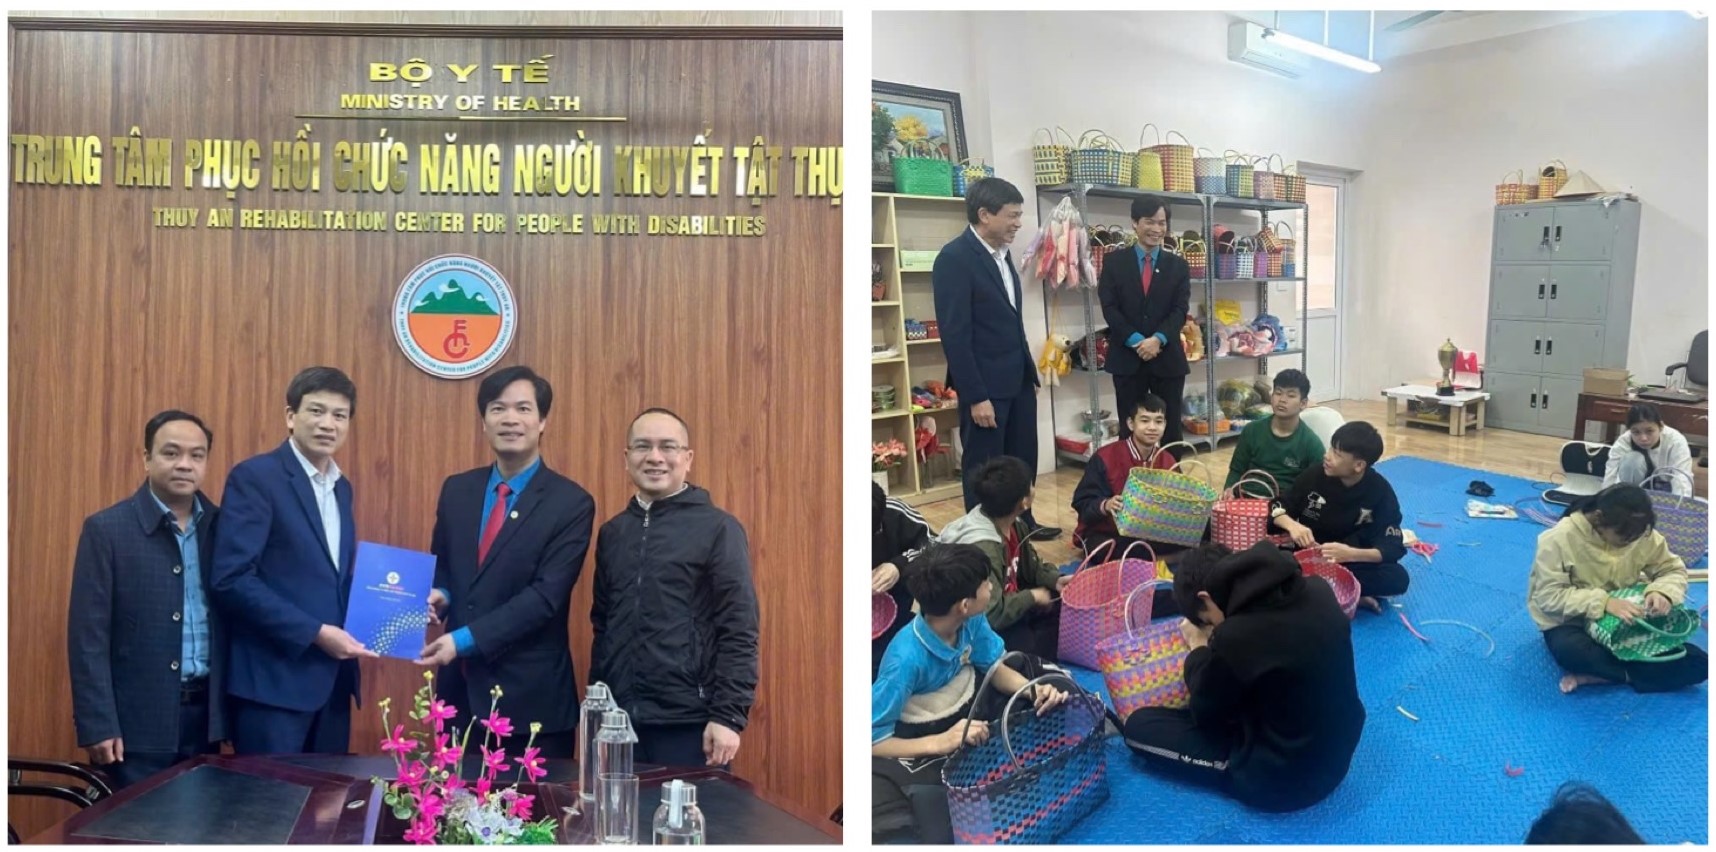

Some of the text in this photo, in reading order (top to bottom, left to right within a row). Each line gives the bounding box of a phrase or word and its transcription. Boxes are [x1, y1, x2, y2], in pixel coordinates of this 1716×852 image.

[369, 54, 555, 88] BỘ Y TẾ
[341, 94, 580, 112] MINISTRY OF HEALTH
[11, 134, 102, 187] TRUNG
[112, 126, 173, 189] TÂM
[184, 138, 261, 200] PHỤC
[272, 123, 321, 193] HỒI
[333, 128, 408, 194] CHỨC
[419, 132, 500, 197] NĂNG
[513, 129, 601, 198] NGƯỜI
[614, 128, 723, 198] KHUYẾT
[733, 135, 782, 206] TẬT
[153, 207, 767, 238] THUY AN REHABILITATION CENTER FOR PEOPLE WITH DISABILITIES
